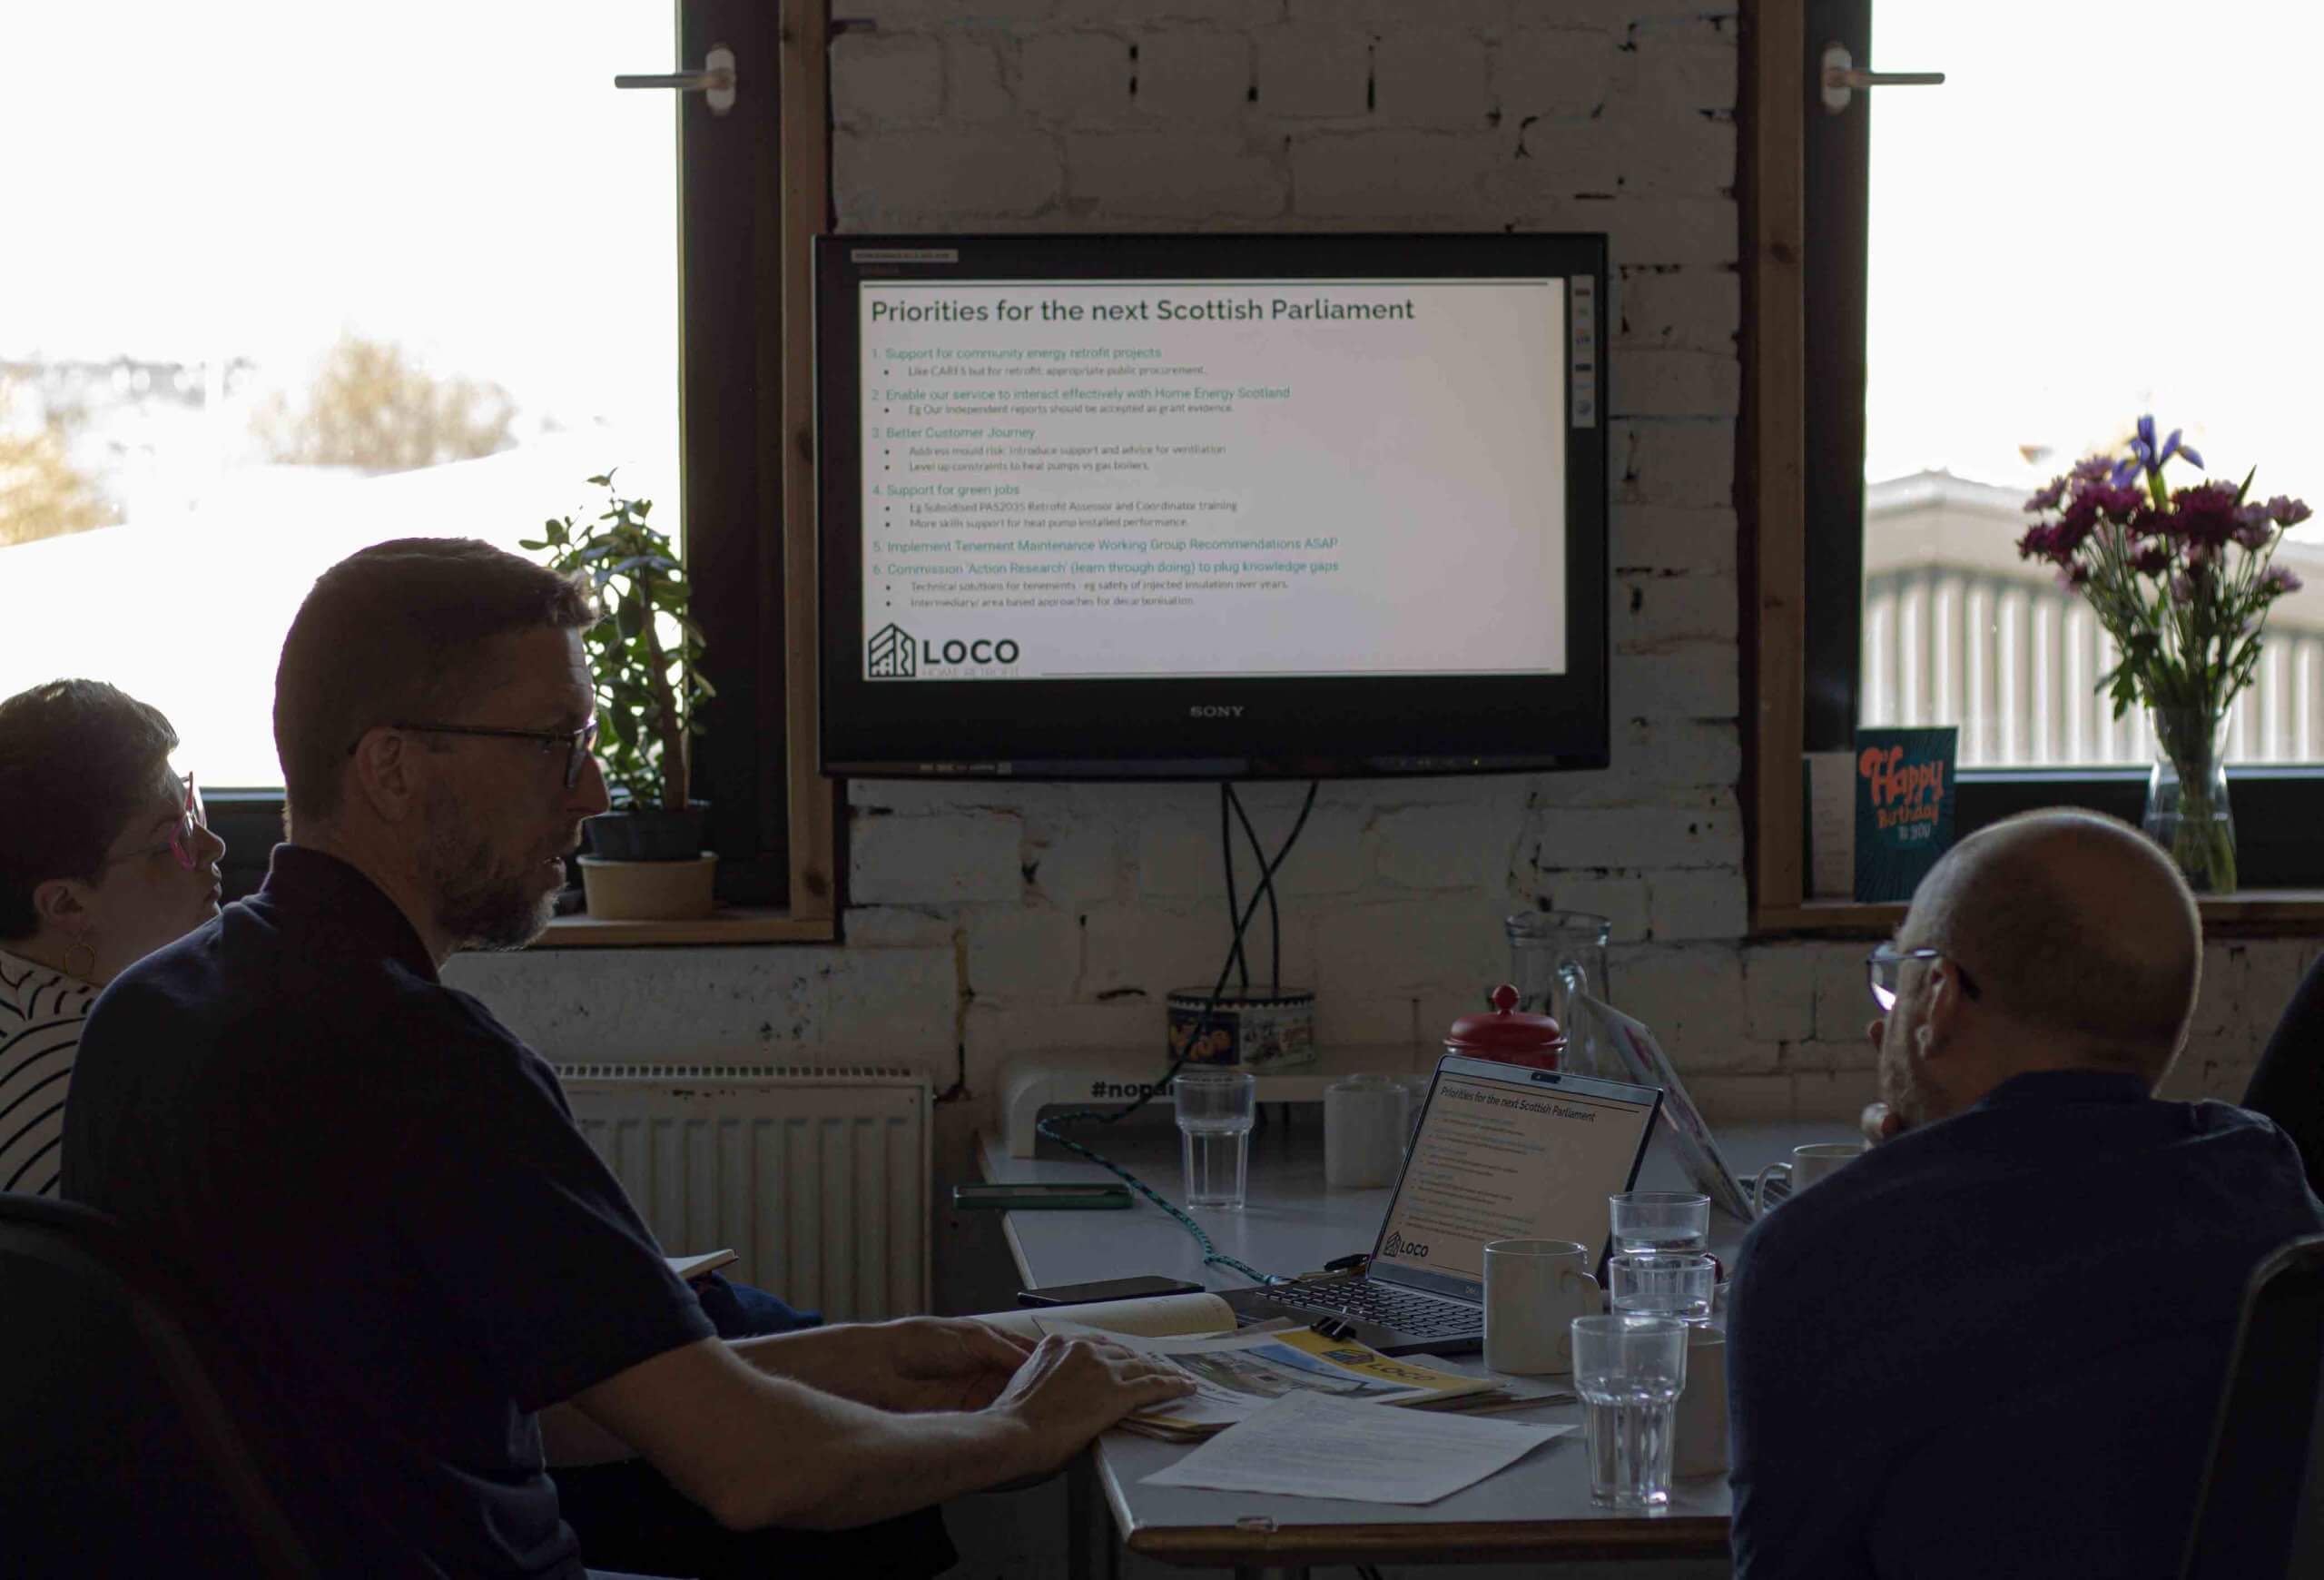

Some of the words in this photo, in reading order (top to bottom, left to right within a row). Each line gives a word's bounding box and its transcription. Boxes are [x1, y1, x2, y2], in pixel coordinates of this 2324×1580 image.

[872, 301, 988, 322] Priorities
[997, 300, 1032, 321] for
[1041, 300, 1083, 321] the
[1092, 299, 1148, 321] next
[1157, 299, 1263, 321] Scottish
[1272, 298, 1413, 320] Parliament
[885, 348, 933, 363] Support
[936, 348, 953, 360] for
[957, 347, 1023, 362] community
[1027, 351, 1067, 362] energy
[1070, 347, 1110, 360] retrofit
[1113, 346, 1161, 361] projects
[886, 389, 926, 401] Enable
[929, 392, 949, 401] our
[953, 388, 996, 400] service
[998, 388, 1010, 400] to
[1013, 388, 1059, 400] interact
[1062, 388, 1123, 403] effectively
[1127, 387, 1152, 400] with
[1154, 387, 1191, 400] Home
[1193, 387, 1235, 402] Energy
[1237, 386, 1290, 399] Scotland
[886, 427, 921, 439] Better
[925, 426, 983, 438] Customer
[988, 426, 1035, 440] Journey
[887, 484, 934, 499] Support
[937, 484, 953, 496] for
[958, 487, 991, 498] green
[994, 483, 1019, 498] jobs
[887, 539, 950, 556] Implement
[955, 538, 1014, 552] Tenement
[1017, 538, 1095, 552] Maintenance
[1098, 538, 1147, 554] Working
[1149, 538, 1187, 554] Group
[1189, 538, 1302, 551] Recommendations
[1305, 537, 1337, 550] ASAP
[887, 562, 963, 575] Commission
[1070, 561, 1106, 577] (learn
[1109, 560, 1153, 576] through
[1157, 560, 1196, 576] doing)
[1198, 560, 1210, 573] to
[1214, 560, 1239, 576] plug
[1242, 559, 1307, 575] knowledge
[1309, 563, 1337, 575] gaps
[923, 639, 1019, 665] LOCO
[1190, 705, 1244, 717] SONY
[1859, 746, 1944, 805] Happy
[1440, 1085, 1473, 1101] Priorities
[1474, 1091, 1486, 1102] for
[1487, 1093, 1501, 1105] the
[1501, 1097, 1520, 1110] next
[1520, 1100, 1552, 1115] Scottish
[1552, 1104, 1596, 1122] Parliament
[1399, 1241, 1429, 1258] LOCO
